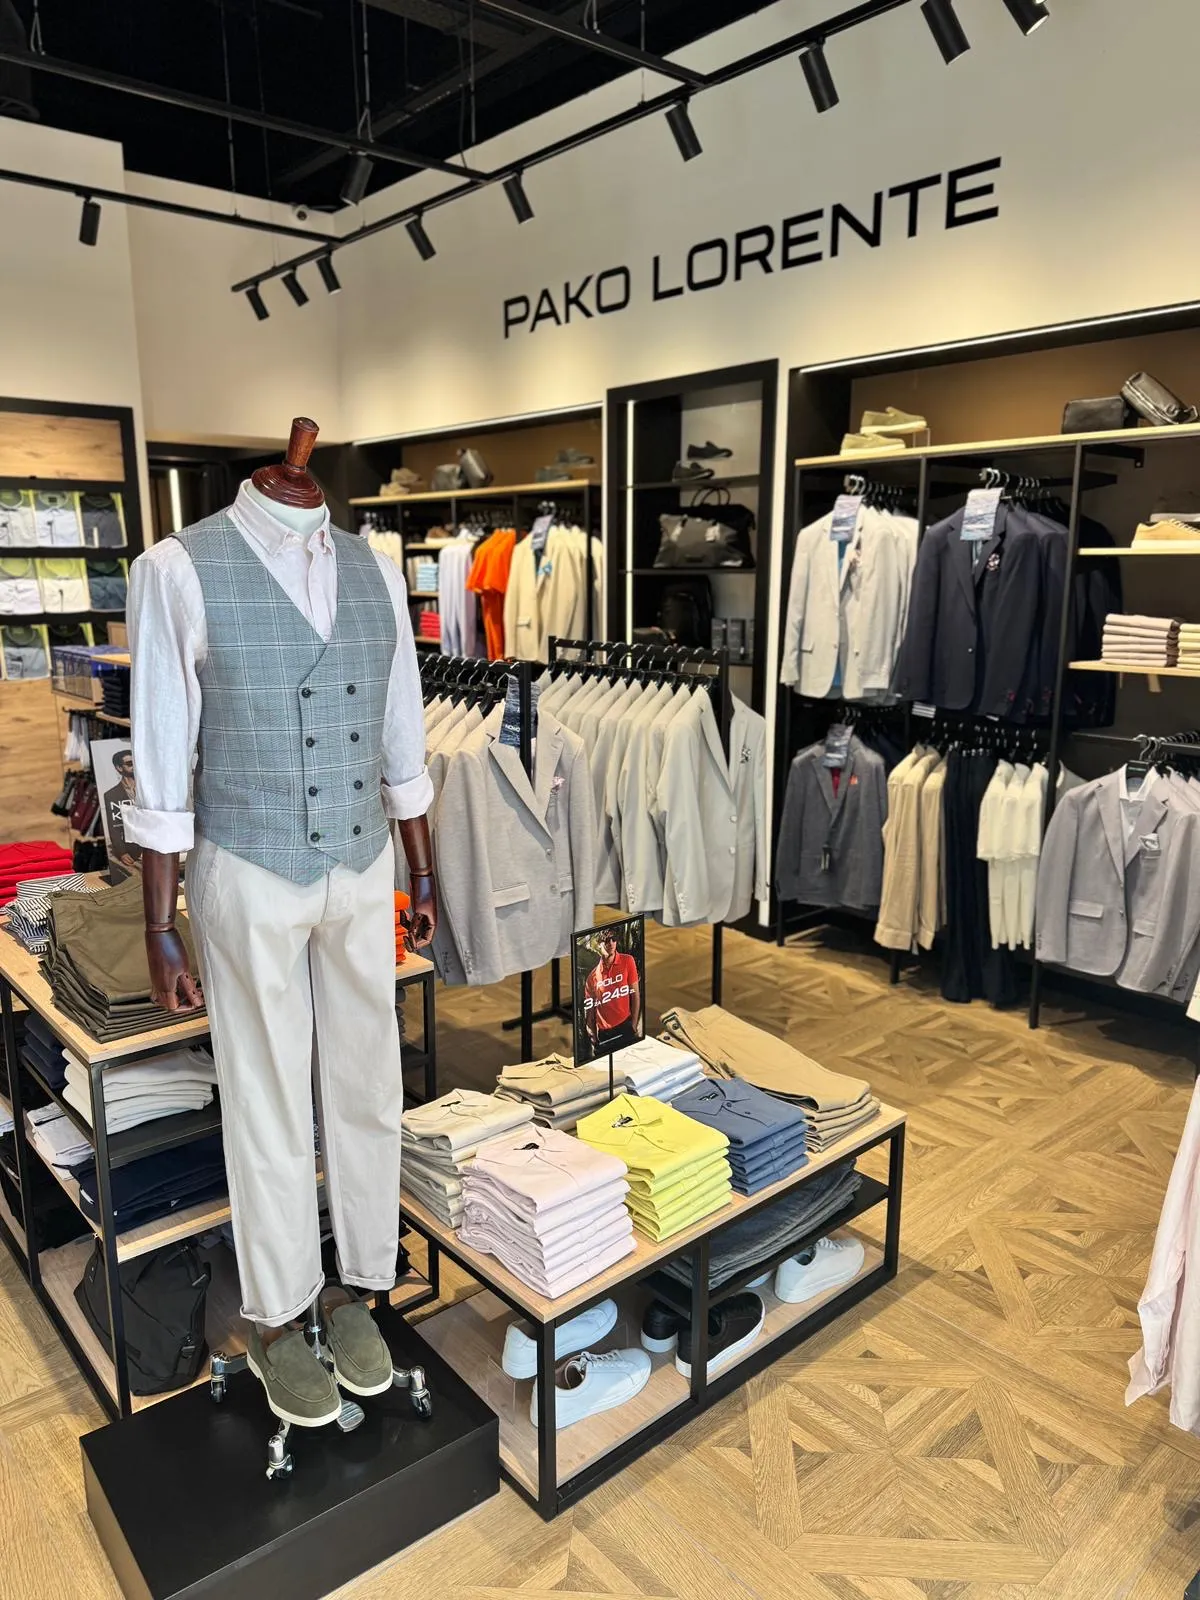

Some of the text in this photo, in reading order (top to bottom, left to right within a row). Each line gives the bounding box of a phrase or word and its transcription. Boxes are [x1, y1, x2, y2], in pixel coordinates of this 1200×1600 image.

[503, 157, 1002, 338] PAKO LORENTE
[597, 974, 623, 990] POLO
[583, 998, 594, 1010] 3
[602, 985, 629, 1004] 249
